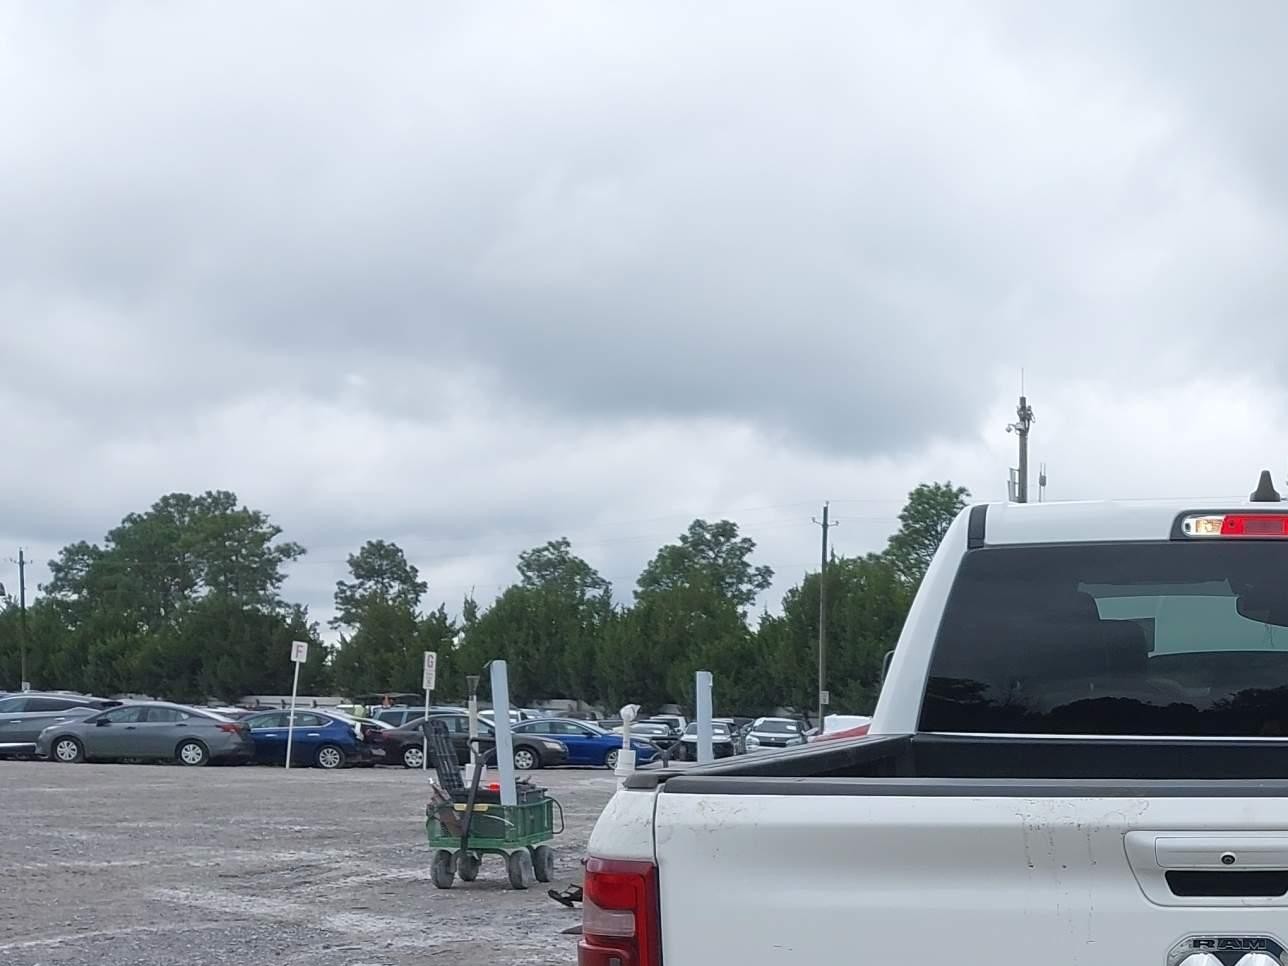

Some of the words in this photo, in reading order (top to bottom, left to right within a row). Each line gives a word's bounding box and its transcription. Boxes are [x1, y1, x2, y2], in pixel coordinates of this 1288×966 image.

[296, 644, 304, 658] F
[427, 654, 434, 668] G
[1191, 938, 1266, 950] RAM
